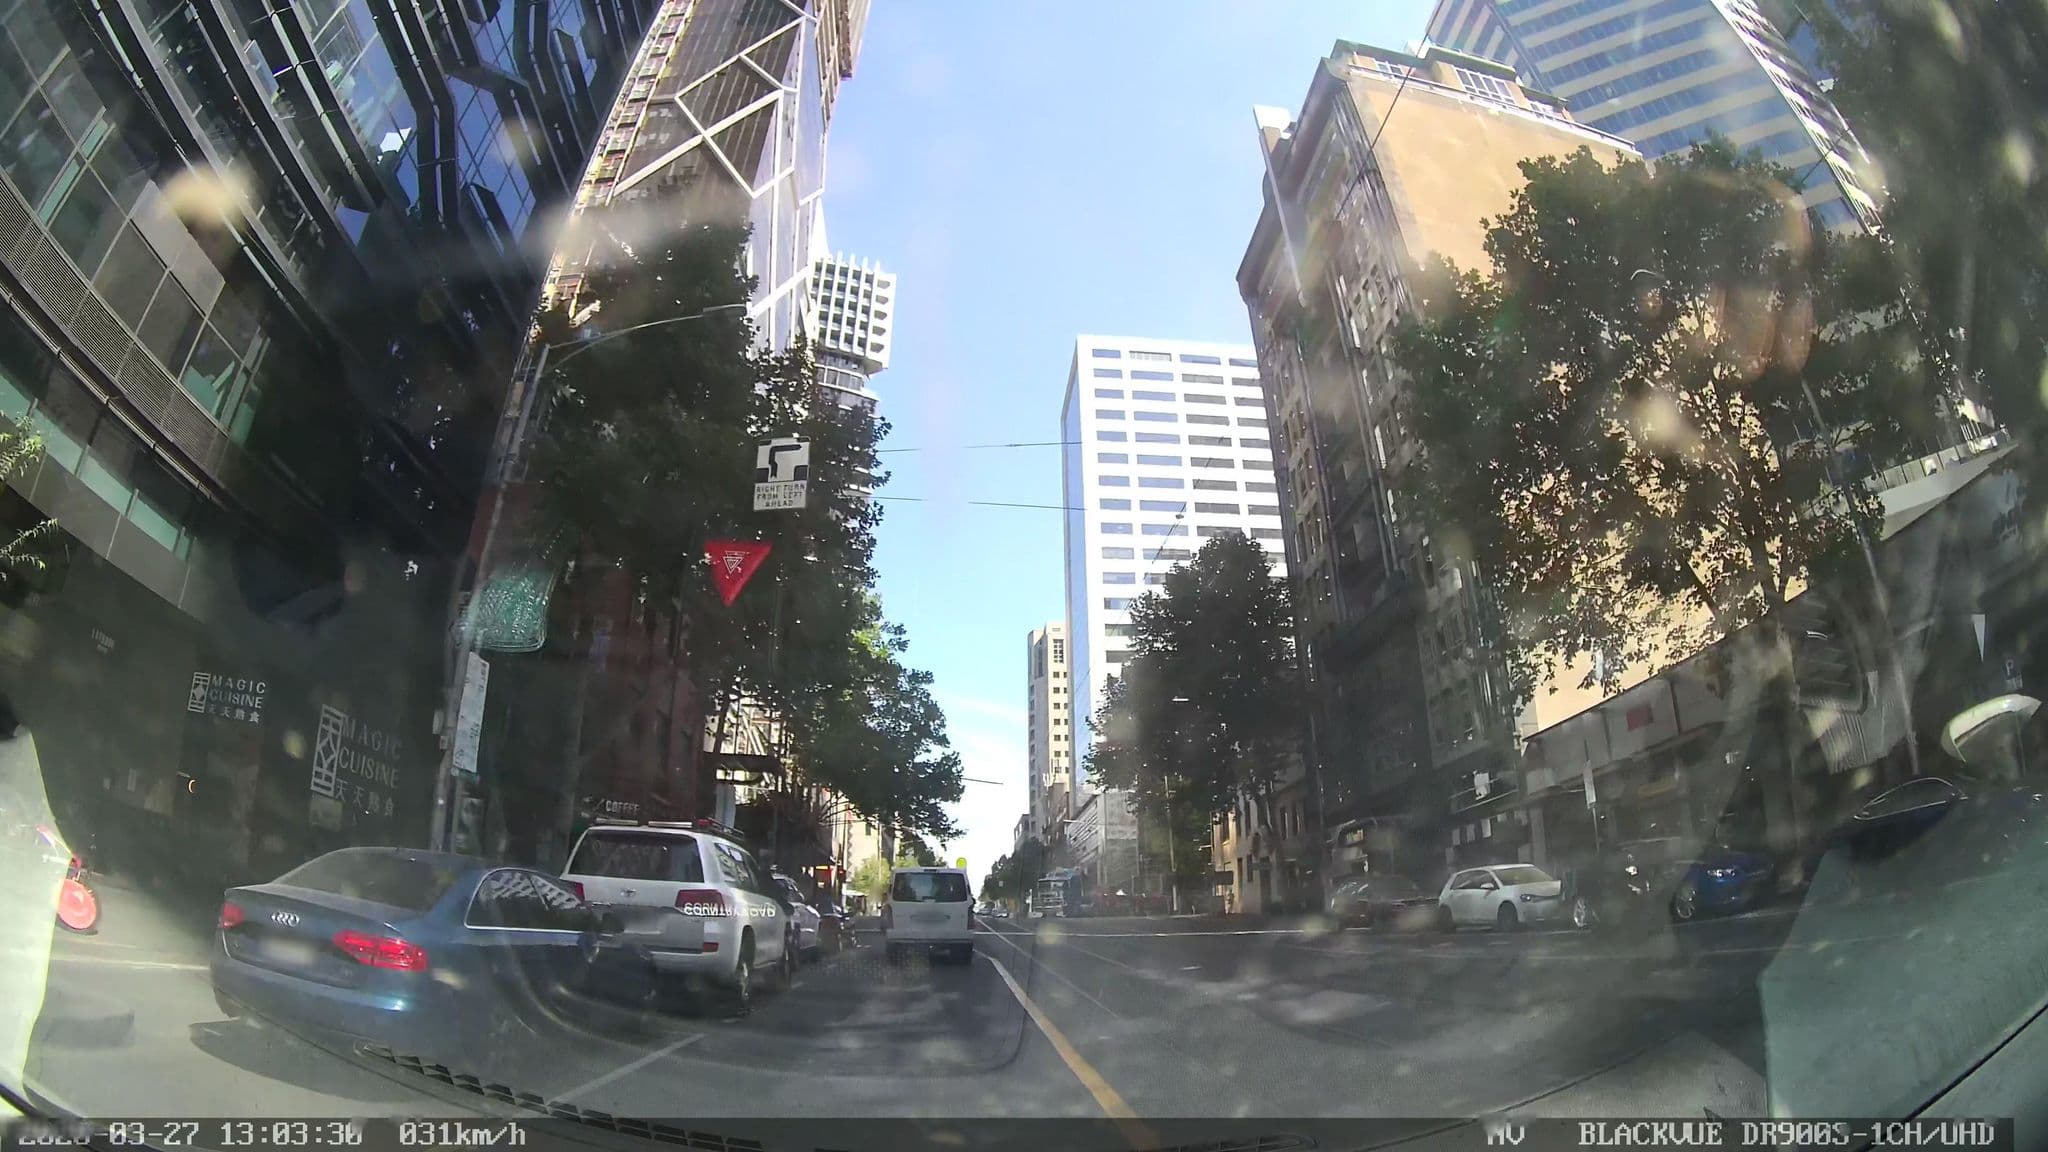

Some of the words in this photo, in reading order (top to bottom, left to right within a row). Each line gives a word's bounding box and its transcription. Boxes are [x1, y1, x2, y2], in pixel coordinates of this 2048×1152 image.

[757, 485, 782, 493] RIGHT
[783, 483, 805, 491] TURN
[757, 493, 778, 501] FROM
[783, 491, 803, 499] LEFT
[765, 499, 794, 508] AHEAD
[212, 675, 266, 694] MAGIC
[209, 688, 264, 709] CUISINE
[342, 716, 403, 760] MAGIC
[338, 746, 400, 789] CUISINE
